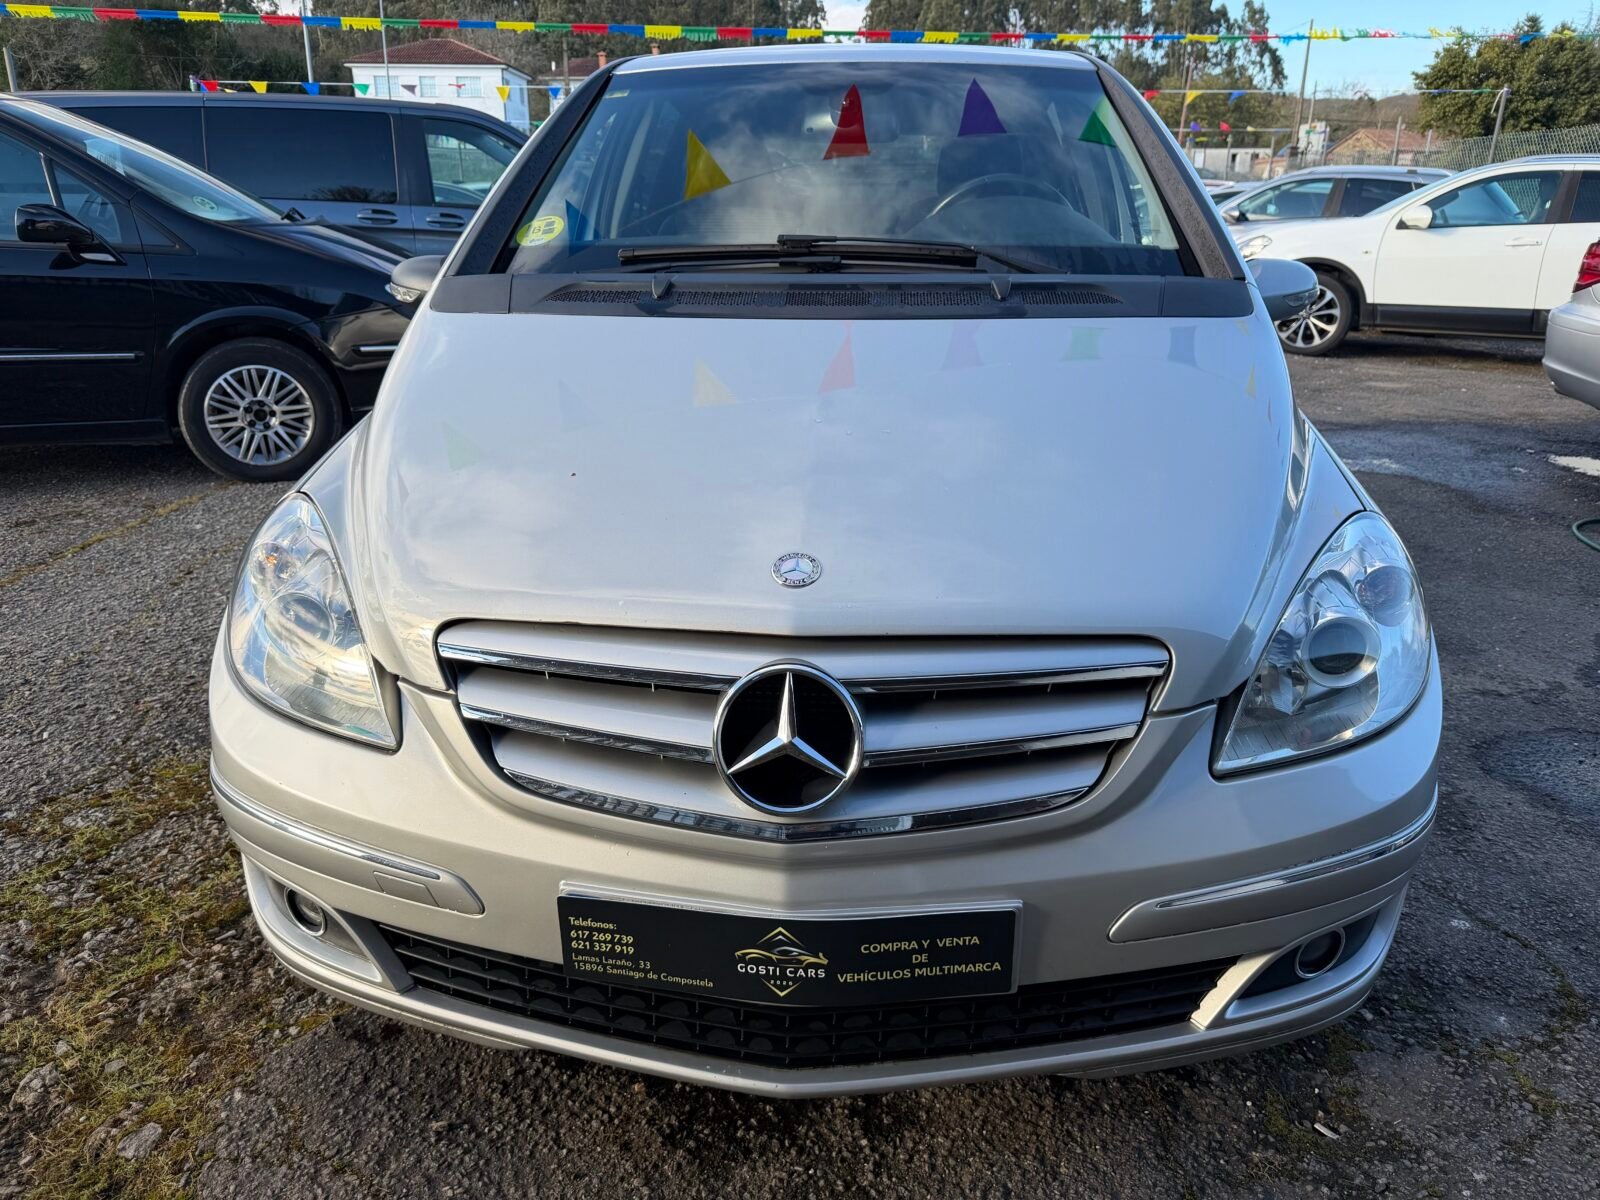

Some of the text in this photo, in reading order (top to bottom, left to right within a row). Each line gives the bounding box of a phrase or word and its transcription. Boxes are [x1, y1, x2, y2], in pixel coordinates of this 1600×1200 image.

[568, 916, 617, 930] Telefonos:
[570, 929, 634, 944] 617 269 739
[571, 940, 634, 955] 621 337 919
[860, 936, 980, 954] COMPRA Y VENTA
[572, 952, 600, 963] Lamas
[639, 960, 651, 969] 33
[912, 953, 929, 964] DE
[574, 962, 714, 988] 15896 Santiago de Compostela
[737, 963, 826, 978] GOSTI CARS
[837, 962, 1001, 983] VEHÍCULOS MULTIMARCA
